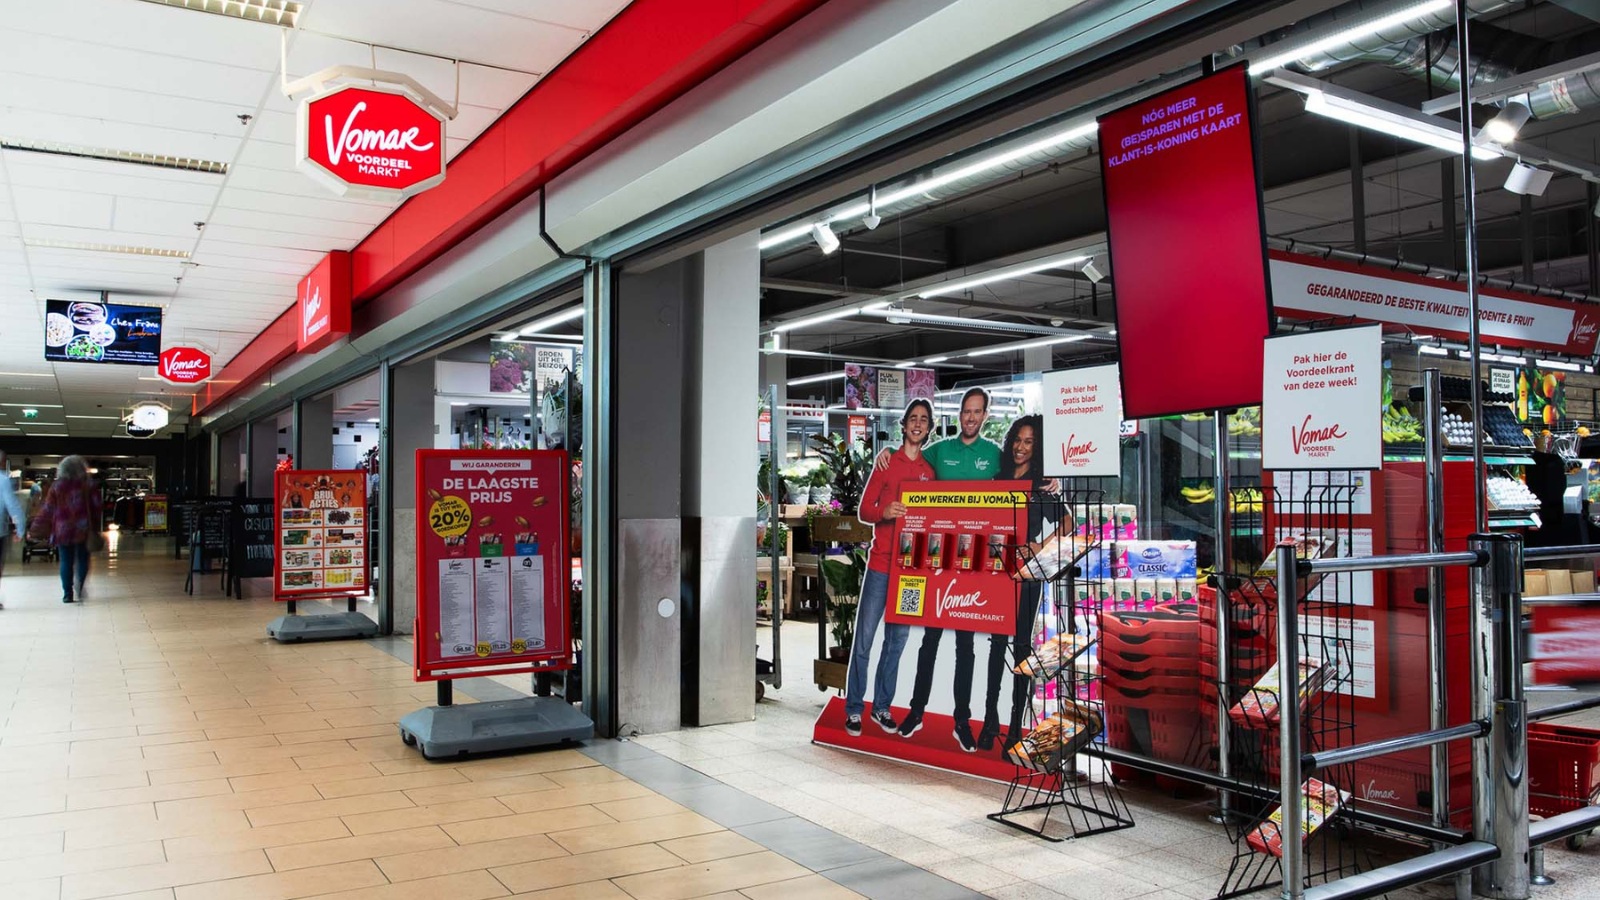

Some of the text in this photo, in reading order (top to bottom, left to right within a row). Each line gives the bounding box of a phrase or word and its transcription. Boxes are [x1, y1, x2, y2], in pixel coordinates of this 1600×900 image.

[1142, 97, 1196, 125] NÓG MEER
[1121, 103, 1224, 149] (BE)SPAREN MET DE
[325, 102, 434, 166] Vomar
[1108, 114, 1242, 167] KLANT-IS-KONING KAART
[346, 153, 412, 170] VOORDEEL
[358, 164, 400, 178] MARKT
[1307, 283, 1534, 327] GEGARANDEERD DE BESTE KWALITEIT ROENTE & FRUIT
[164, 352, 208, 376] Vomar
[1294, 352, 1347, 364] Pak hier de
[1286, 364, 1354, 378] Voordeelkrant
[1284, 377, 1358, 390] van deze week!
[1062, 396, 1080, 405] gratis
[1055, 404, 1104, 415] Boodschappen!
[1292, 414, 1347, 454] Vomar
[1062, 434, 1098, 465] Vomar
[443, 478, 538, 490] DE LAAGSTE
[314, 490, 334, 500] BRUL
[470, 492, 512, 504] PRIJS
[929, 496, 966, 504] WERKEN
[967, 496, 981, 504] BIJ
[983, 496, 1019, 504] VOMAR!
[309, 499, 339, 509] ACTIES
[431, 508, 470, 528] 20%
[436, 523, 468, 533] GOEDKOPER
[1138, 564, 1168, 572] CLASSIC
[936, 579, 987, 618] Vomar
[949, 612, 1005, 621] VOORDEELMARKT
[1362, 780, 1400, 801] Vomar
